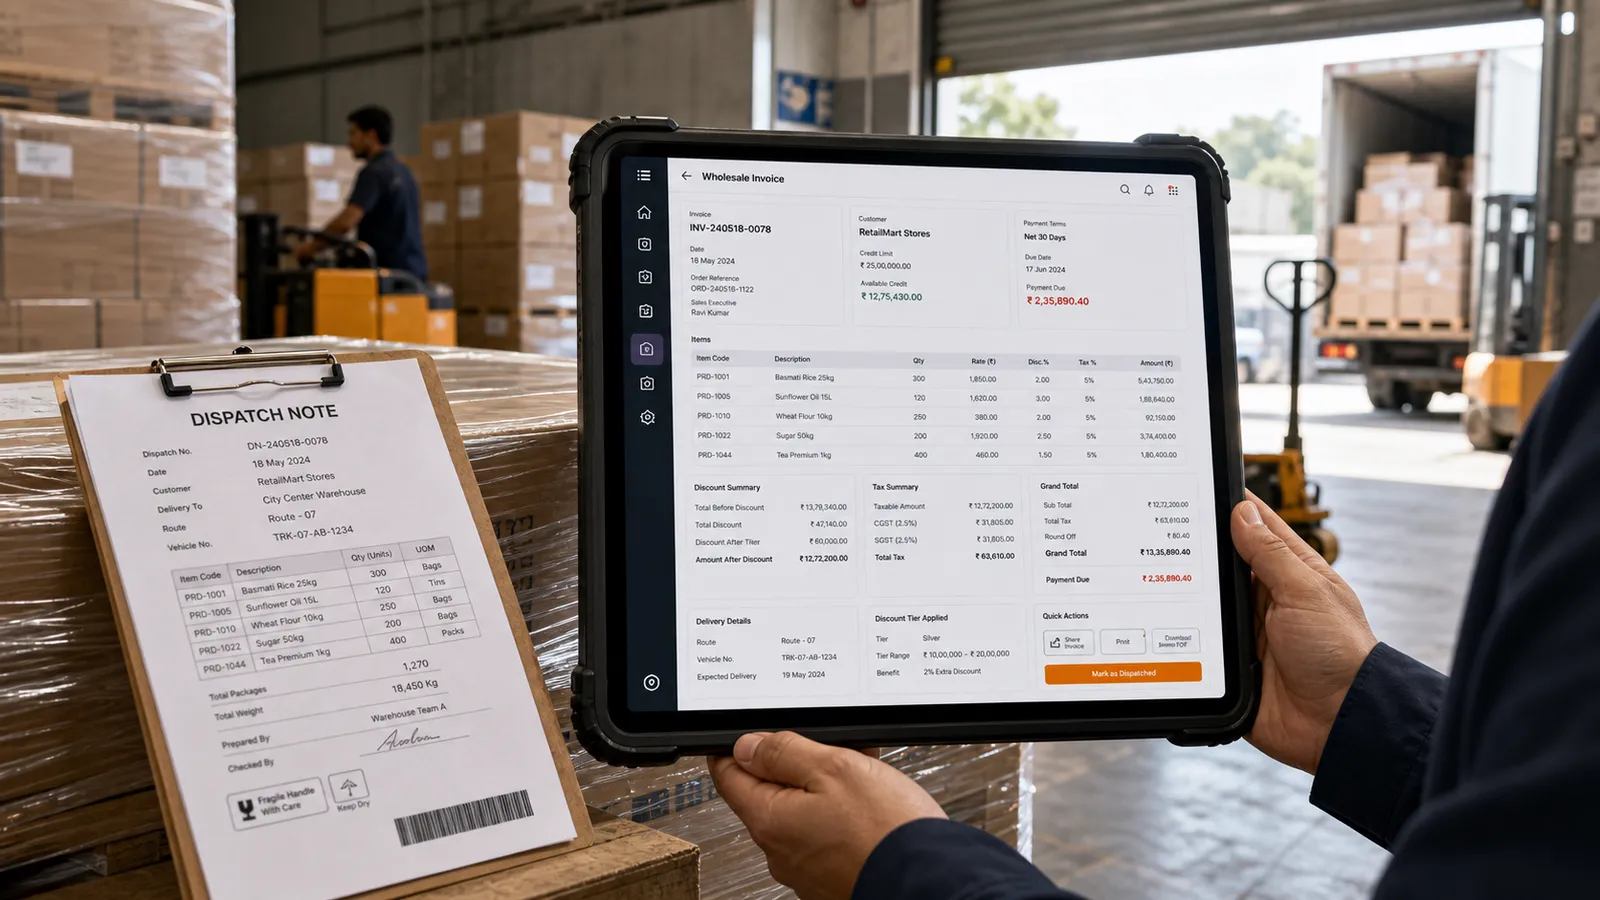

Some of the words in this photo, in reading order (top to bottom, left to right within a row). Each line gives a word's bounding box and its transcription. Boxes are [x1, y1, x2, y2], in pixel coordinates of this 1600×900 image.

[702, 172, 749, 182] Wholesale
[752, 174, 784, 183] Invoice
[690, 224, 771, 233] INV-240518-0078
[859, 228, 902, 236] RetailMart
[904, 229, 930, 237] Stores
[1049, 234, 1066, 242] Days
[861, 292, 866, 300] ₹
[869, 293, 922, 301] 12,75,430.00
[1027, 296, 1032, 304] ₹
[1035, 296, 1089, 306] 2,35,890.40
[913, 357, 924, 365] Qty
[818, 374, 834, 382] 25kg
[191, 408, 283, 426] DISPATCH
[288, 405, 338, 420] NOTE
[247, 437, 328, 450] DN-240518-0078
[142, 449, 177, 458] Dispatch
[252, 460, 264, 468] 18
[266, 459, 284, 467] May
[287, 456, 310, 465] 2024
[257, 475, 304, 485] RetailMart
[153, 486, 190, 495] Customer
[727, 484, 760, 492] Summary
[263, 496, 281, 504] City
[283, 494, 314, 502] Center
[315, 489, 366, 499] Warehouse
[158, 505, 190, 513] Delivery
[268, 514, 295, 523] Route
[304, 510, 315, 519] 07
[273, 525, 353, 541] TRK-07-AB-1234
[167, 543, 196, 551] Vehicle
[415, 544, 435, 553] UOM
[351, 554, 365, 562] Qty
[367, 550, 392, 560] (Units)
[236, 565, 281, 576] Description
[422, 563, 442, 571] Bags
[200, 572, 221, 581] Code
[370, 569, 386, 577] 300
[1046, 576, 1075, 584] Payment
[241, 583, 275, 595] Basmati
[296, 579, 317, 587] 25kg
[375, 585, 391, 594] 120
[185, 590, 226, 601] PRD-1001
[433, 595, 452, 604] Bags
[246, 601, 288, 612] Sunflower
[290, 598, 302, 606] Oil
[304, 596, 318, 604] 15L
[380, 602, 396, 611] 250
[189, 607, 232, 619] PRD-1005
[438, 612, 458, 620] Bags
[251, 620, 278, 629] Wheat
[280, 617, 301, 625] Flour
[303, 614, 324, 622] 10kg
[385, 619, 401, 628] 200
[696, 618, 725, 626] Delivery
[194, 625, 236, 637] PRD-1010
[442, 628, 464, 636] Packs
[256, 638, 280, 647] Sugar
[283, 634, 304, 643] 50kg
[390, 636, 406, 644] 400
[199, 643, 241, 655] PRD-1022
[277, 652, 314, 662] Premium
[316, 649, 331, 657] 1kg
[203, 660, 246, 673] PRD-1044
[403, 659, 429, 671] 1,270
[392, 681, 423, 693] 18,450
[425, 680, 438, 688] Kg
[209, 692, 229, 700] Total
[230, 687, 267, 697] Packages
[214, 711, 234, 720] Total
[235, 707, 263, 717] Weight
[371, 710, 416, 722] Warehouse
[417, 706, 439, 714] Team
[222, 736, 258, 748] Prepared
[259, 735, 270, 743] By
[228, 760, 262, 773] Checked
[264, 759, 274, 767] By
[258, 794, 285, 804] Fragile
[287, 788, 315, 798] Handle
[261, 806, 281, 816] With
[282, 803, 301, 811] Care
[337, 804, 356, 812] Keep
[358, 800, 370, 809] Dry
